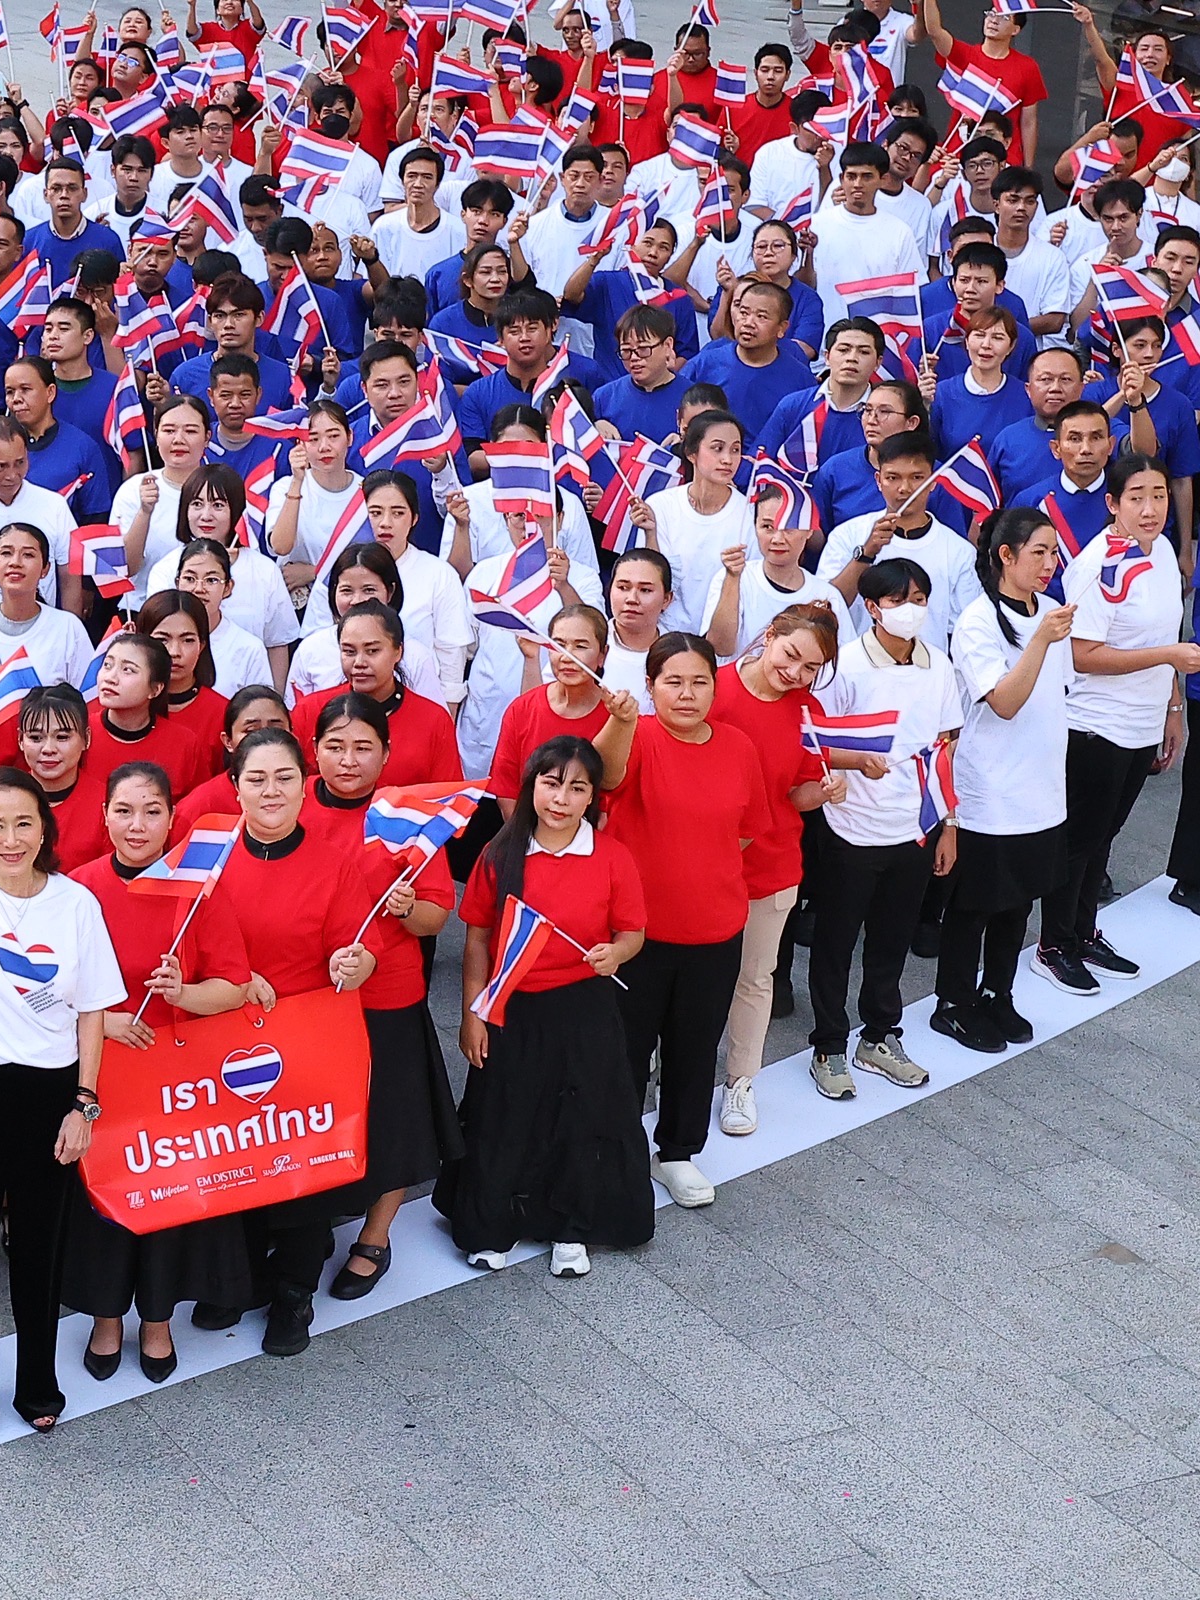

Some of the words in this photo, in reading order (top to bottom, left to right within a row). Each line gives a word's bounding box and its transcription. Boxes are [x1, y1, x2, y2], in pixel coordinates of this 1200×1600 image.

[161, 1077, 217, 1115] เรา
[124, 1102, 335, 1174] ประเทศไทย
[309, 1153, 337, 1166] BANGKOK
[337, 1149, 356, 1160] MALL
[196, 1176, 212, 1188] EM
[213, 1166, 254, 1183] DISTRICT
